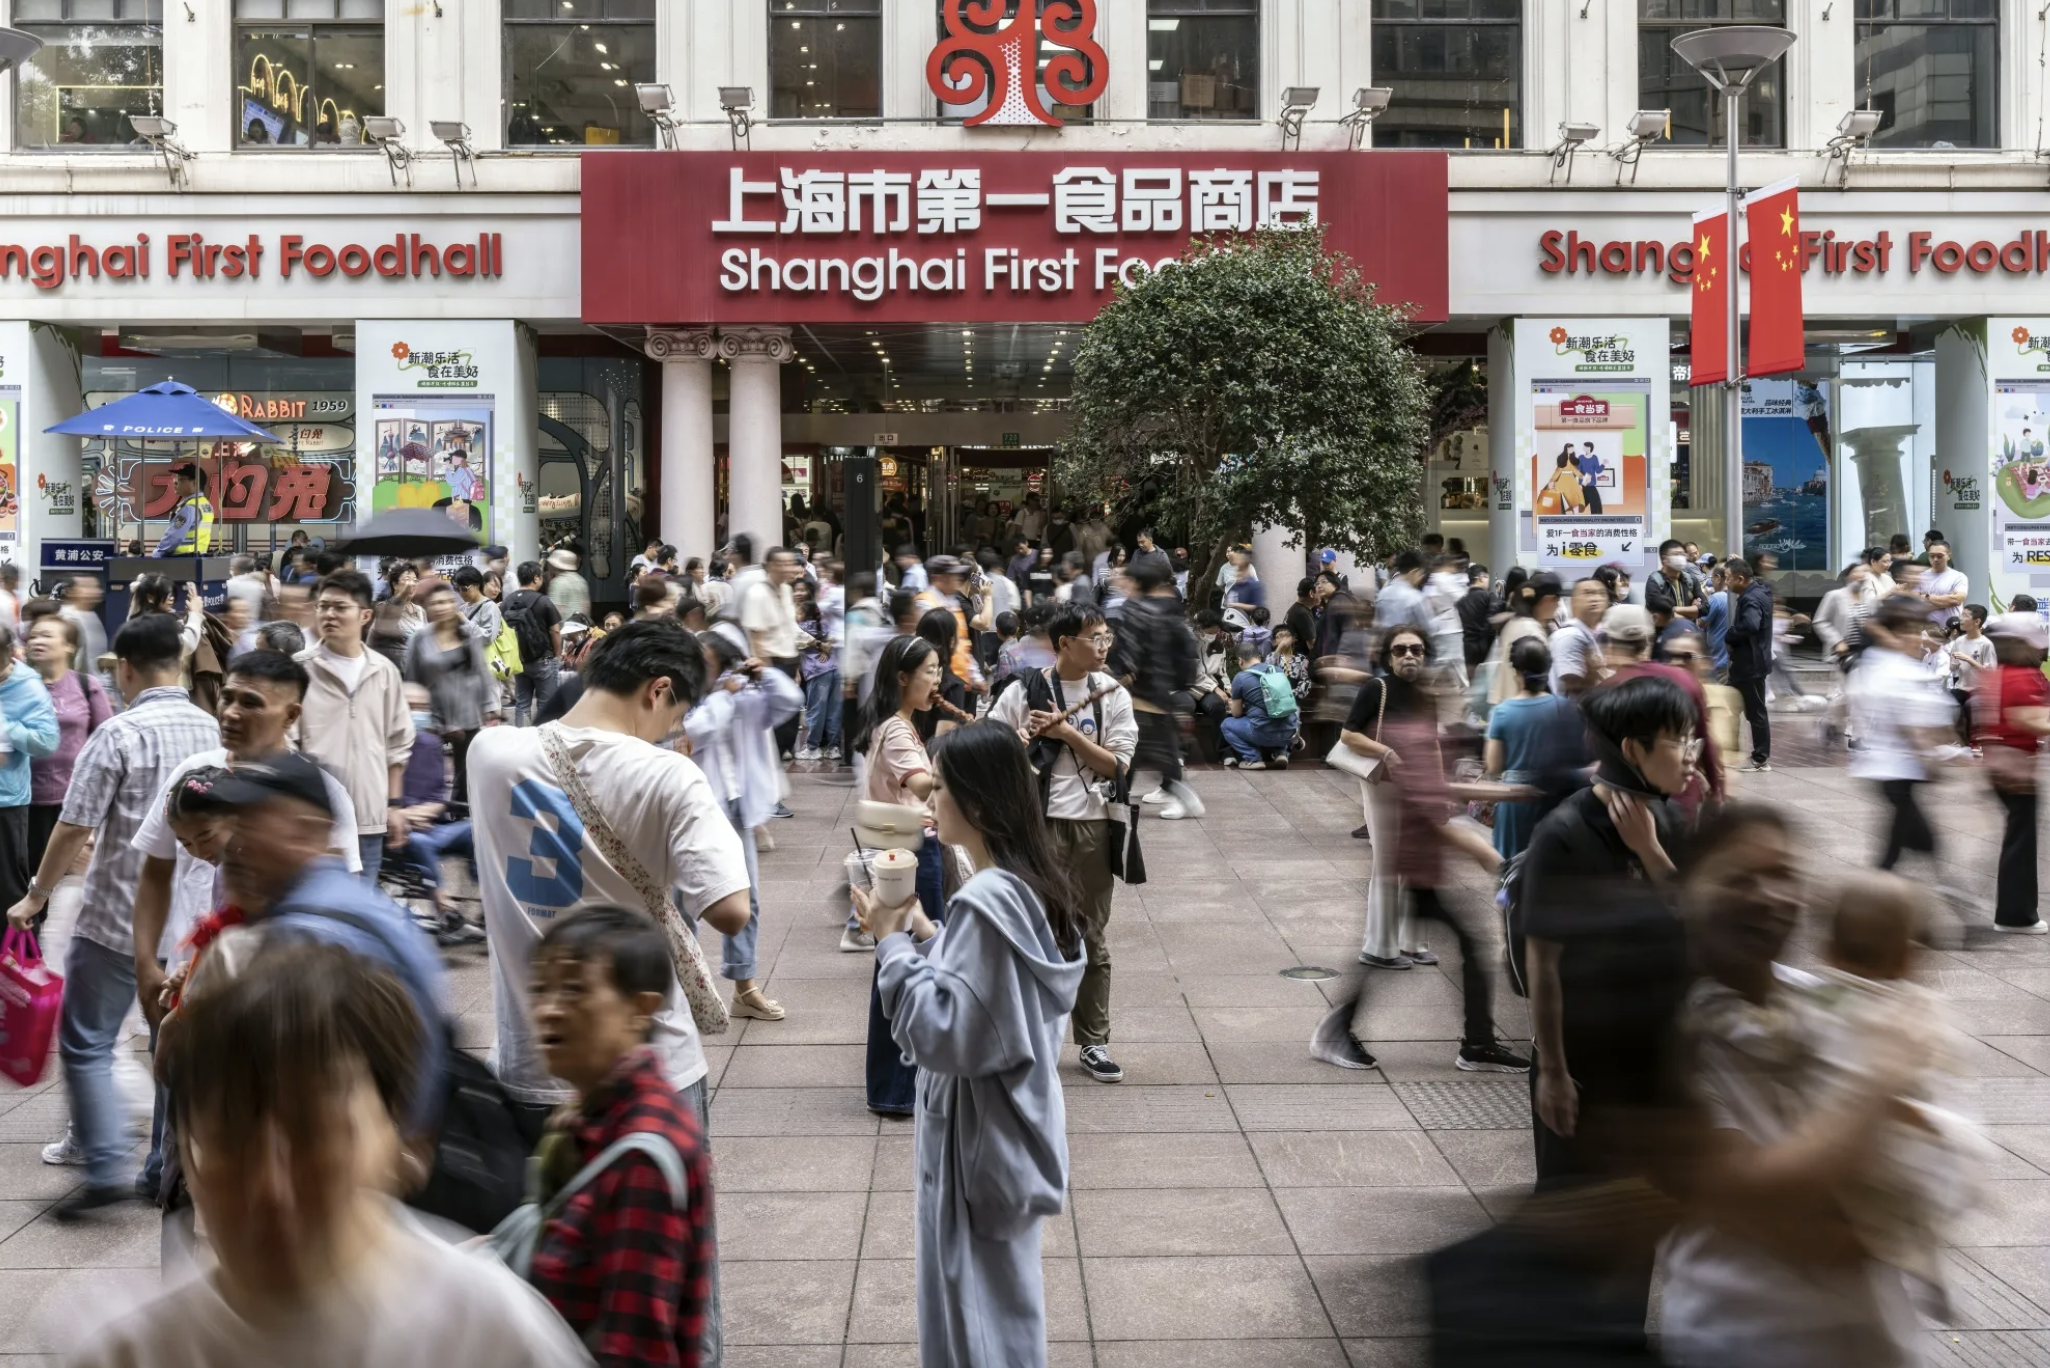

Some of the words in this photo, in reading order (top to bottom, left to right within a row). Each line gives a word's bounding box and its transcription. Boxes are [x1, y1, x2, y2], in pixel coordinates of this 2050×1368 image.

[712, 167, 1320, 233] 上海市第一食品商店
[167, 232, 263, 277] First
[280, 232, 502, 277] Foodhall
[1800, 230, 1893, 273] First
[720, 247, 966, 301] Shanghai
[985, 247, 1080, 292] First
[1566, 337, 1616, 349] 新潮乐活
[408, 352, 460, 364] 新潮乐活
[1585, 350, 1635, 362] 食在美好
[427, 365, 478, 378] 食在美好
[312, 400, 347, 412] 1959
[1563, 404, 1606, 414] 一食当家
[123, 425, 184, 434] POLICE
[856, 474, 863, 483] 6
[1546, 528, 1638, 538] 爱1F一食当家的消费性格
[55, 548, 104, 561] 黄浦公安
[505, 778, 584, 907] 3
[527, 906, 557, 918] FORMAT
